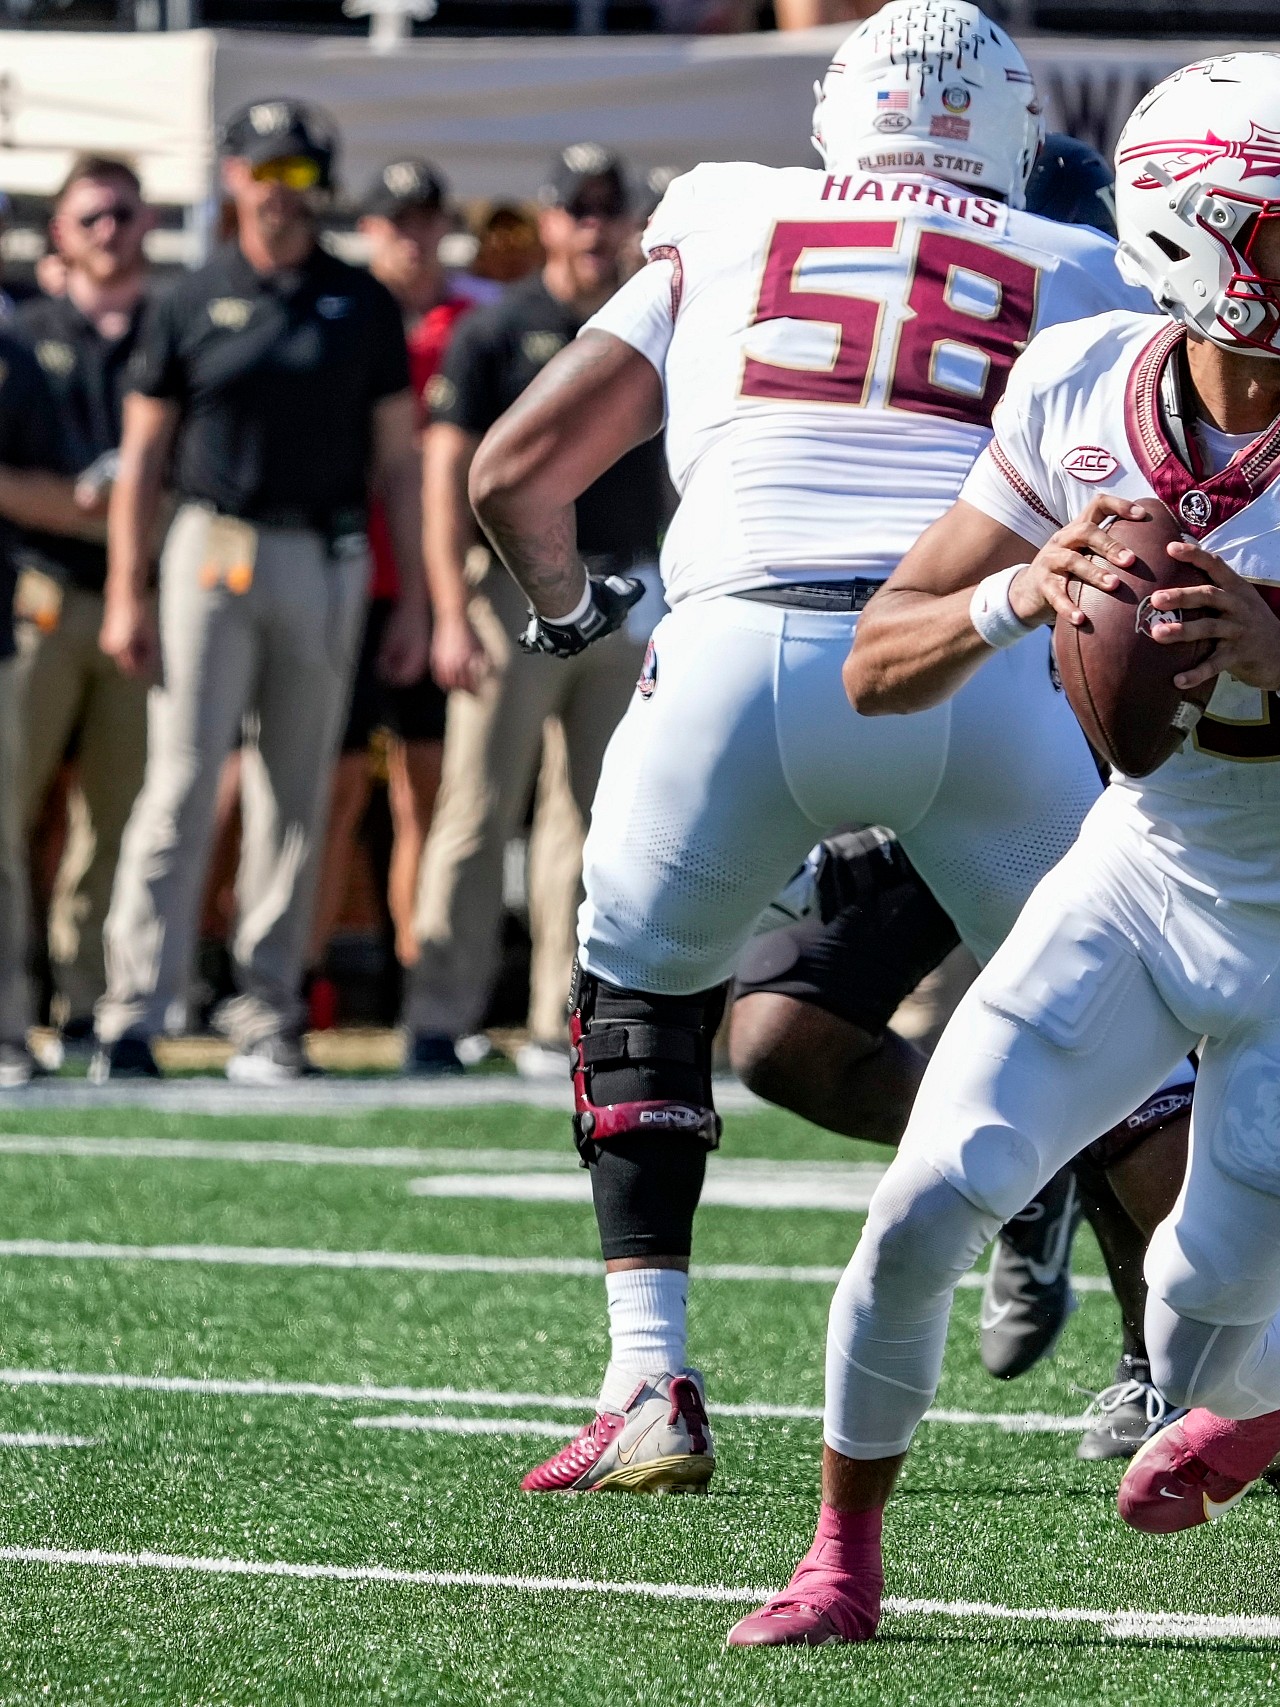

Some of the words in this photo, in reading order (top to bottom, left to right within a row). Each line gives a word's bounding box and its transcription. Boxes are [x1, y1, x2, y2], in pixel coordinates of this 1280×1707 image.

[858, 151, 925, 170] FLORIDA
[933, 153, 984, 176] STATE
[820, 175, 998, 228] HARRIS
[738, 218, 1042, 429] 58
[1070, 454, 1111, 469] ACC
